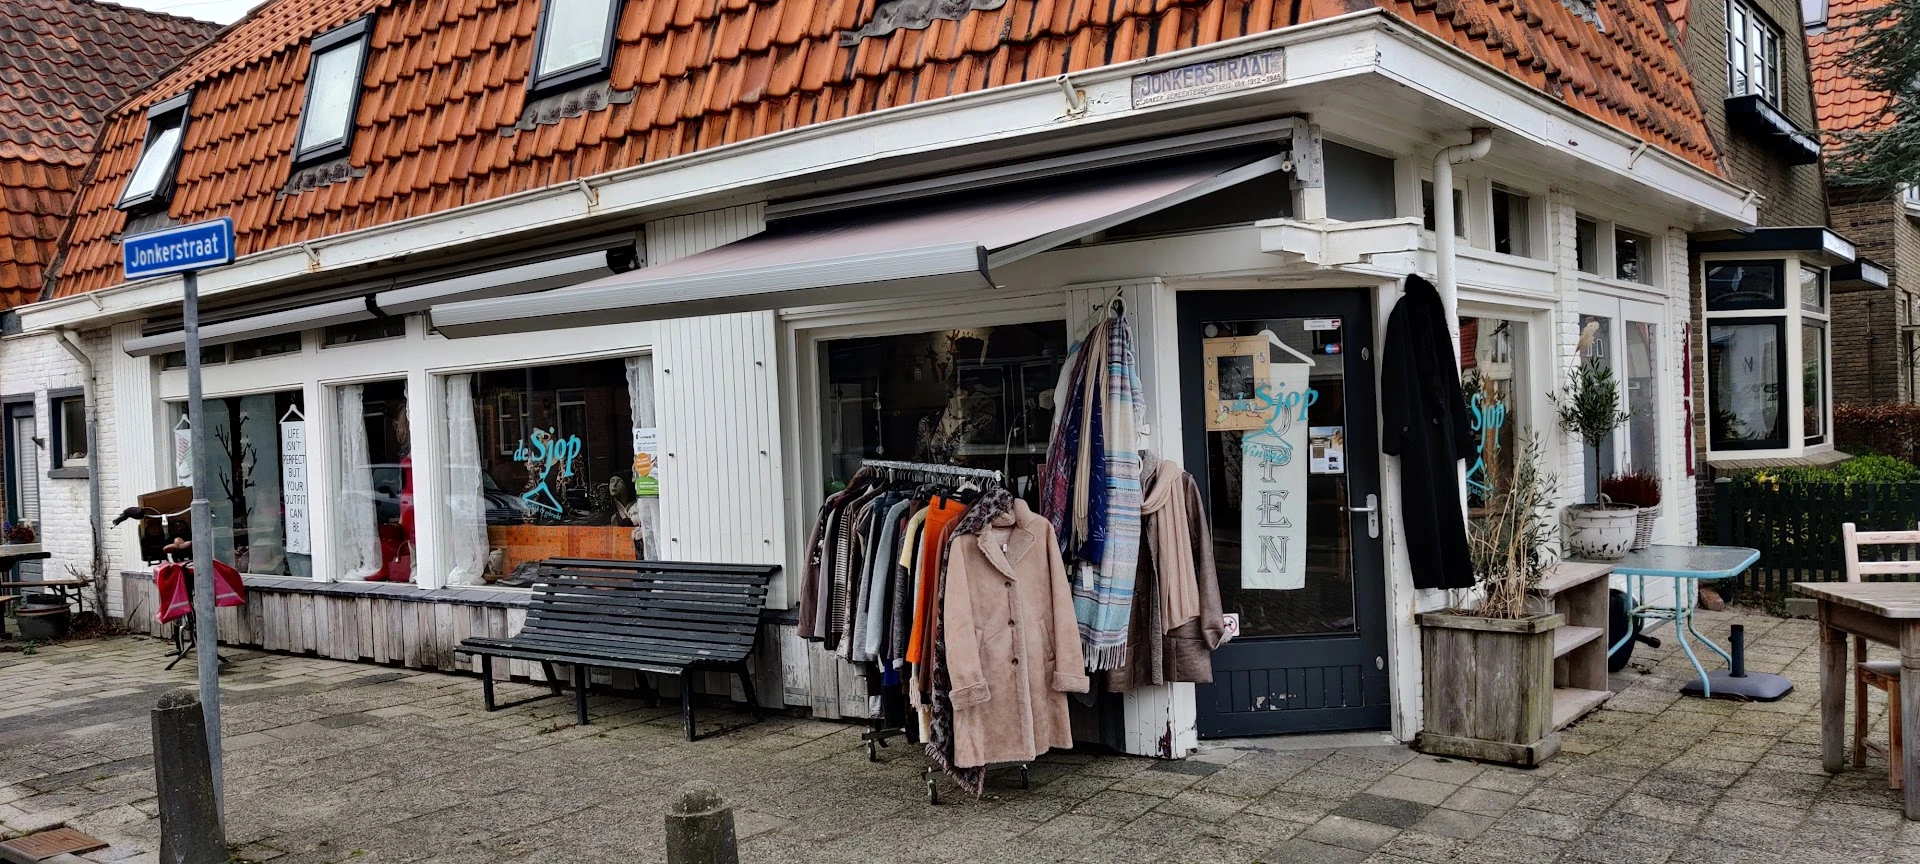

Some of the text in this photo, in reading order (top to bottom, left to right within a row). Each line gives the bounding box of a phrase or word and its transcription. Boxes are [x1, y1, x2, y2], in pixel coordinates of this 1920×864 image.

[1141, 52, 1273, 96] JONKERSTRAAT
[130, 232, 219, 268] Jonkerstraat
[1253, 381, 1319, 425] Sjop
[1470, 392, 1506, 453] Sjop
[287, 428, 300, 439] LIFE
[286, 441, 301, 451] ISN'T
[513, 426, 582, 478] de Sjop
[283, 454, 306, 465] PERFECT
[288, 468, 300, 478] BUT
[286, 481, 304, 491] YOUR
[285, 494, 307, 505] OUTFIT
[289, 508, 303, 519] CAN
[292, 521, 300, 533] BE
